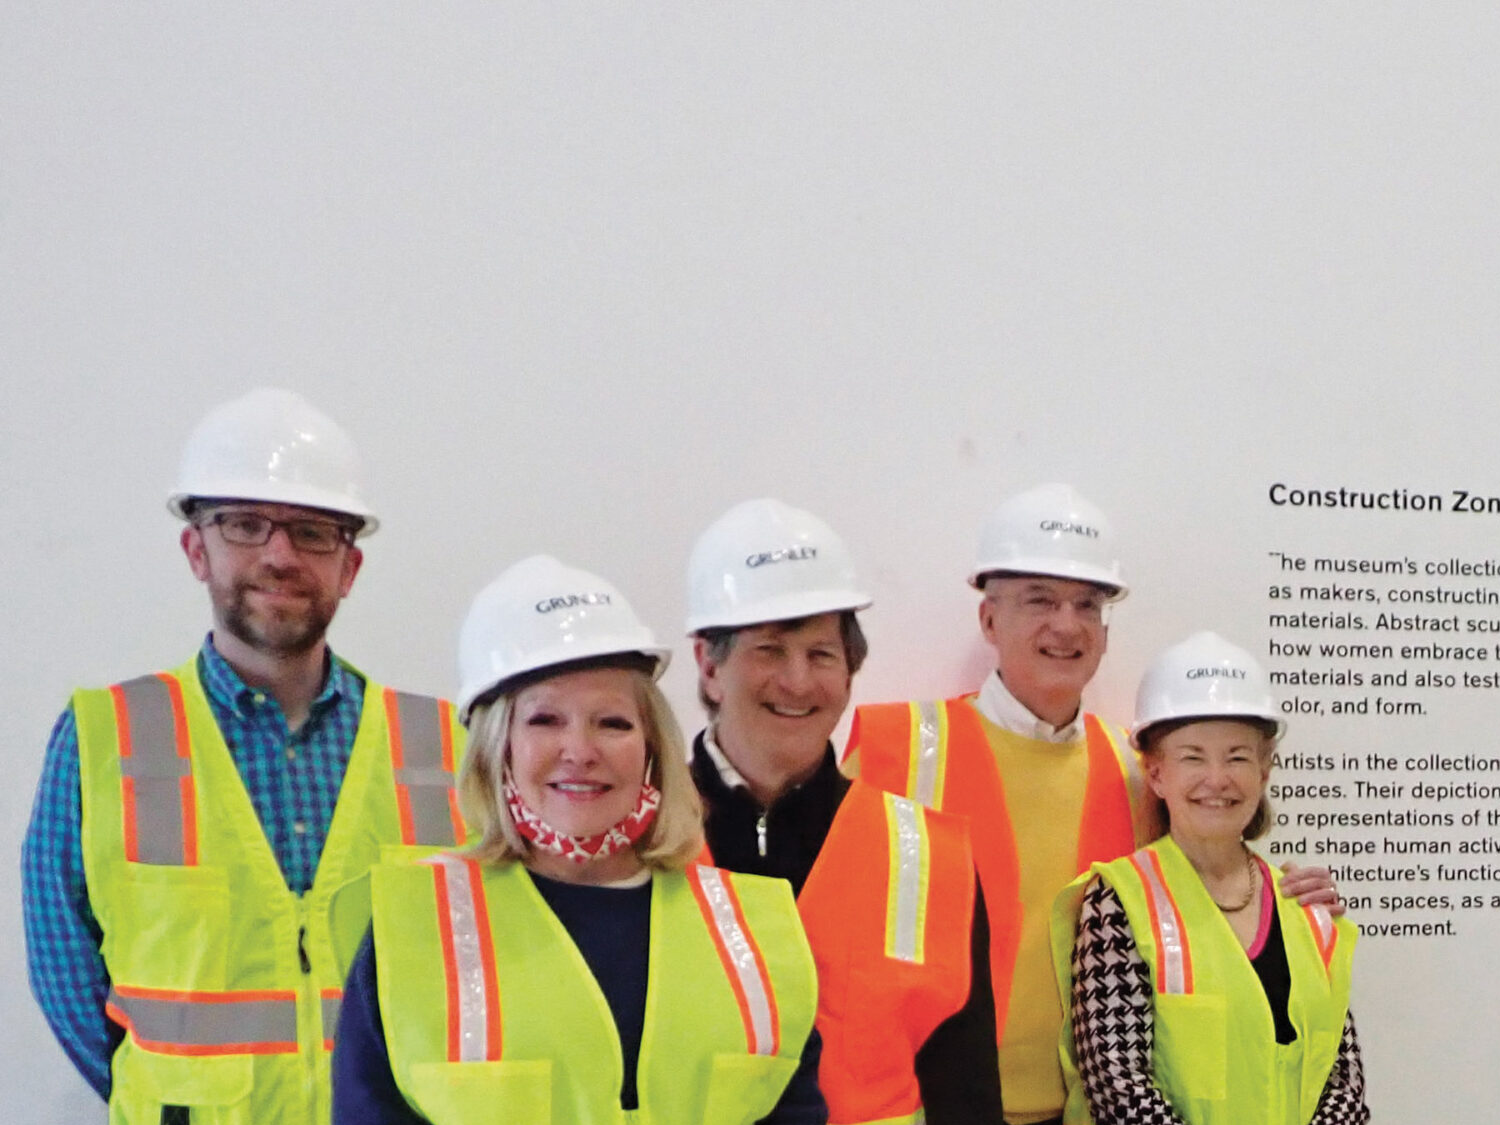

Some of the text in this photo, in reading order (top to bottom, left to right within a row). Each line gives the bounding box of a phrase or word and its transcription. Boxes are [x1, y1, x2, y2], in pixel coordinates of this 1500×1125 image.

[1269, 483, 1442, 512] Construction
[1314, 557, 1418, 575] museum's
[1269, 586, 1292, 600] as
[1300, 584, 1380, 604] makers,
[1270, 612, 1368, 630] materials.
[1376, 613, 1459, 632] Abstract
[1270, 638, 1312, 656] how
[1320, 645, 1393, 659] women
[1401, 643, 1488, 661] embrace
[1270, 668, 1363, 686] materials
[1371, 670, 1407, 687] and
[1415, 670, 1456, 688] also
[1463, 672, 1500, 688] test
[1281, 696, 1427, 716] olor, and form.
[1271, 753, 1335, 770] Artists
[1343, 753, 1359, 770] in
[1366, 753, 1398, 771] the
[1405, 754, 1500, 771] collection
[1271, 785, 1346, 801] spaces.
[1354, 781, 1404, 799] Their
[1272, 812, 1289, 826] o
[1297, 809, 1454, 830] representations
[1462, 809, 1480, 826] of
[1270, 837, 1306, 854] and
[1315, 837, 1376, 857] shape
[1384, 837, 1451, 854] human
[1328, 864, 1430, 883] hitecture's
[1380, 896, 1454, 912] spaces,
[1461, 896, 1484, 908] as
[1491, 896, 1500, 908] a
